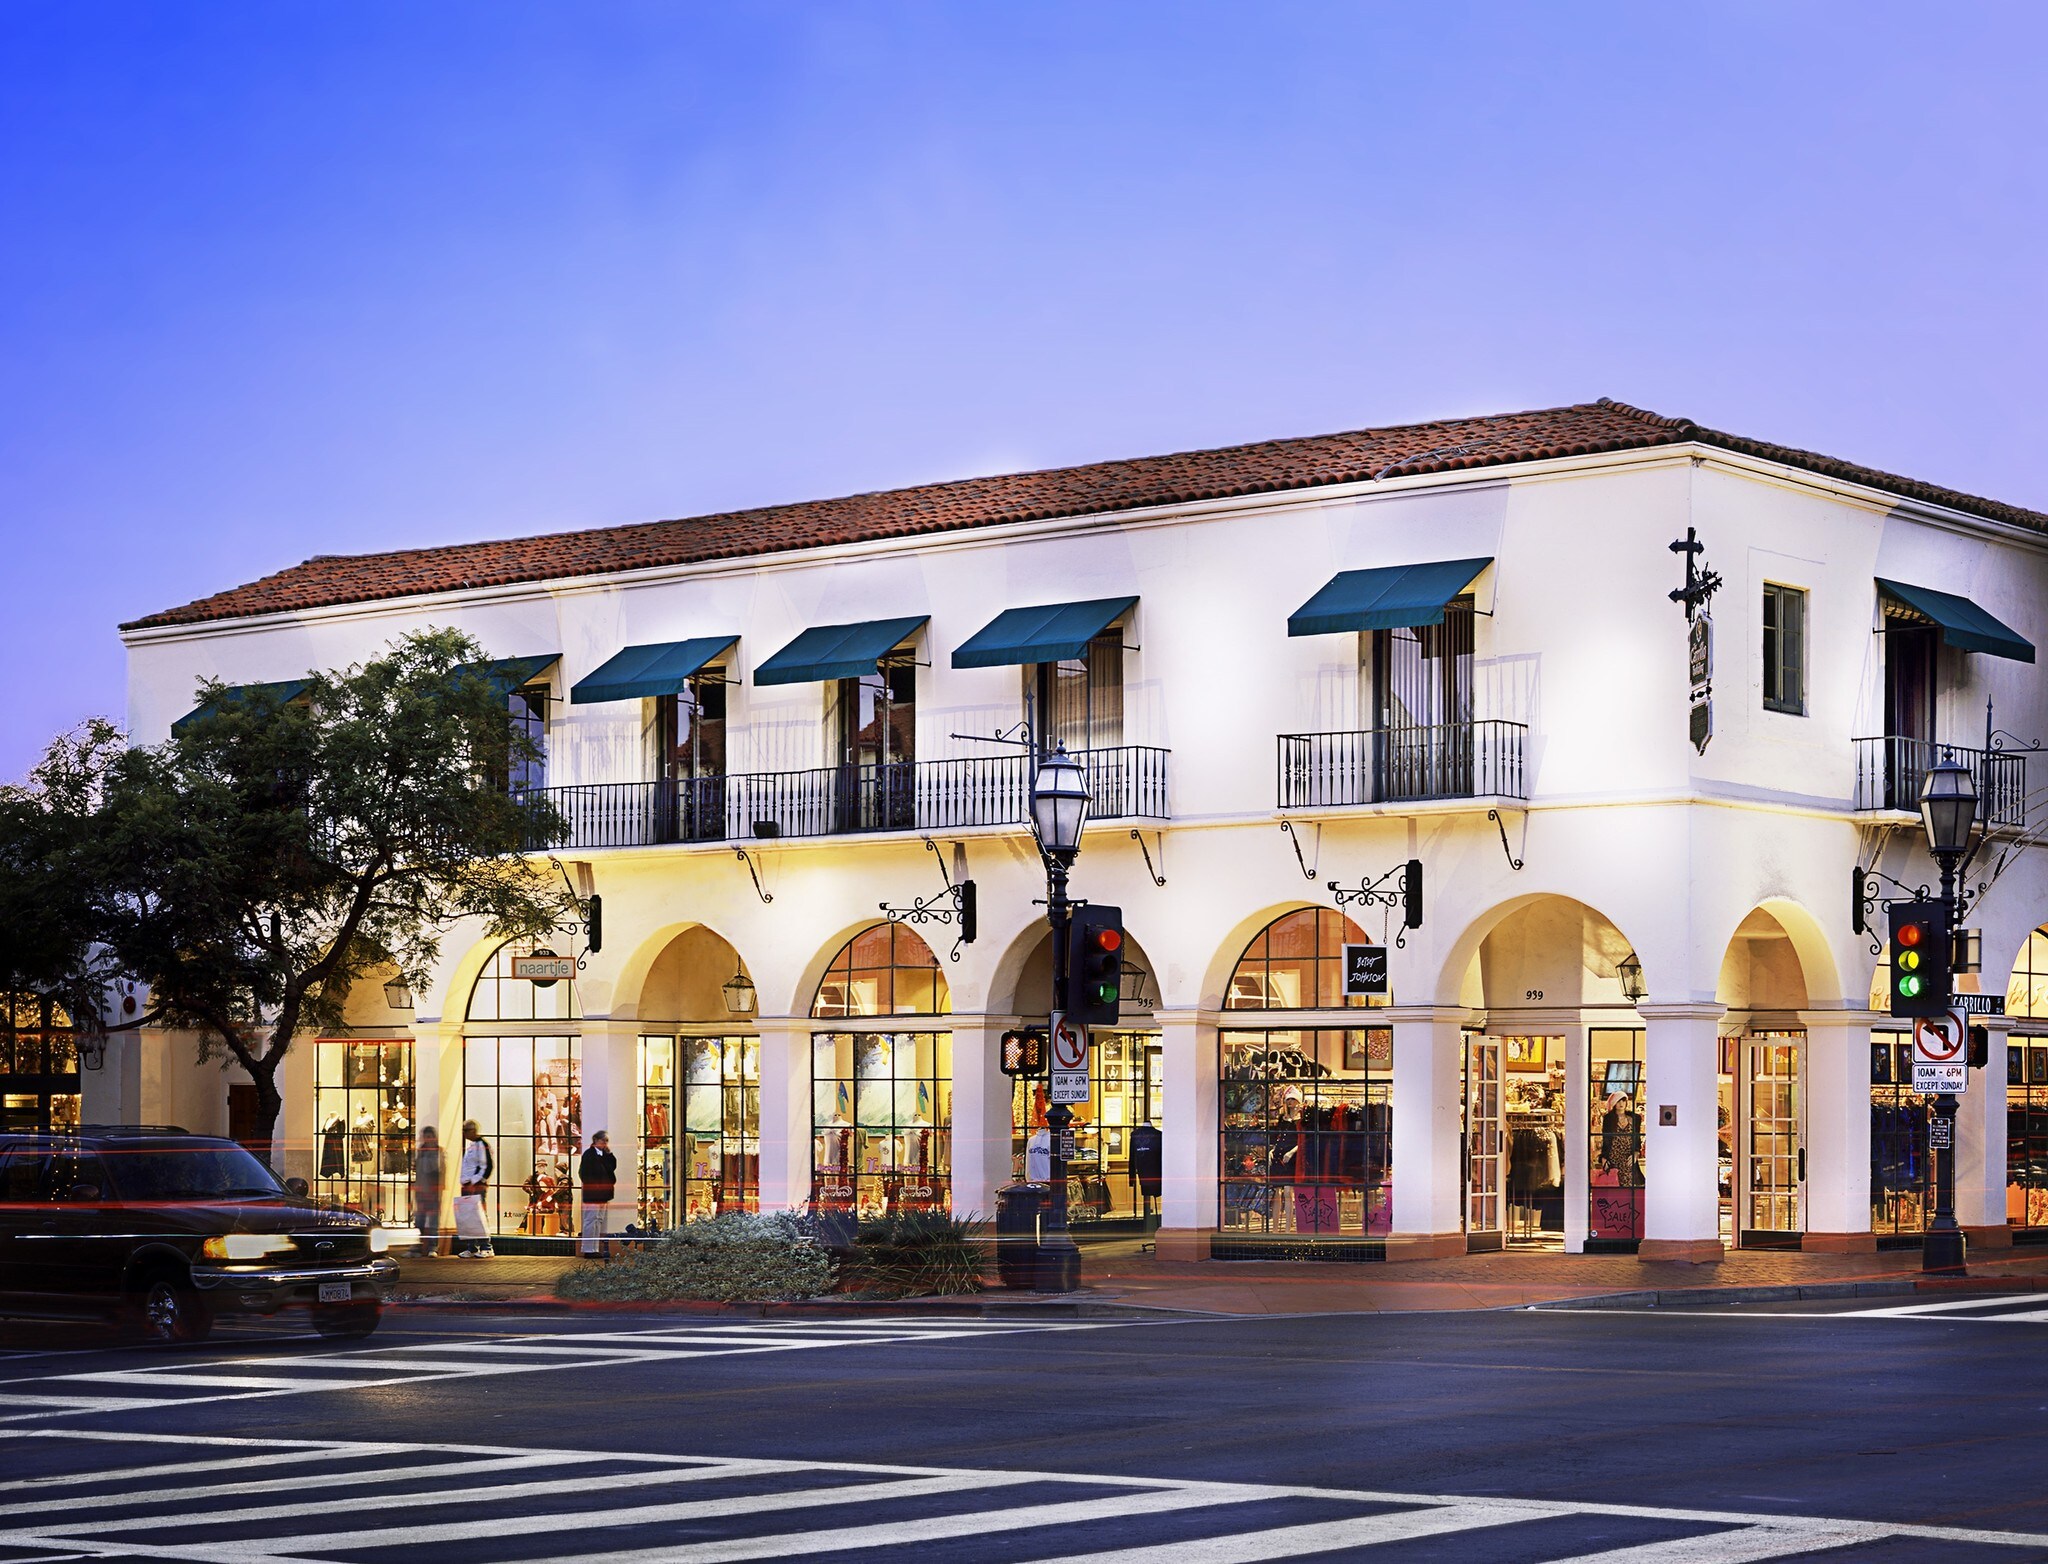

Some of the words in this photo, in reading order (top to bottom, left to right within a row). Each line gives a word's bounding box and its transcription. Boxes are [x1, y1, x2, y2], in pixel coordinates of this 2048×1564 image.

[520, 960, 568, 976] naartjie
[1526, 989, 1543, 1000] 939
[1137, 997, 1154, 1008] 935
[1917, 1068, 1936, 1077] 10AM
[1946, 1068, 1962, 1077] 6PM
[1054, 1076, 1068, 1086] 10AM
[1075, 1076, 1087, 1086] 6PM
[1916, 1081, 1938, 1090] EXCEPT
[1940, 1081, 1963, 1090] SUNDAY
[1054, 1090, 1070, 1099] EXCEPT
[1071, 1090, 1088, 1099] SUNDAY
[1607, 1211, 1632, 1224] SALE!
